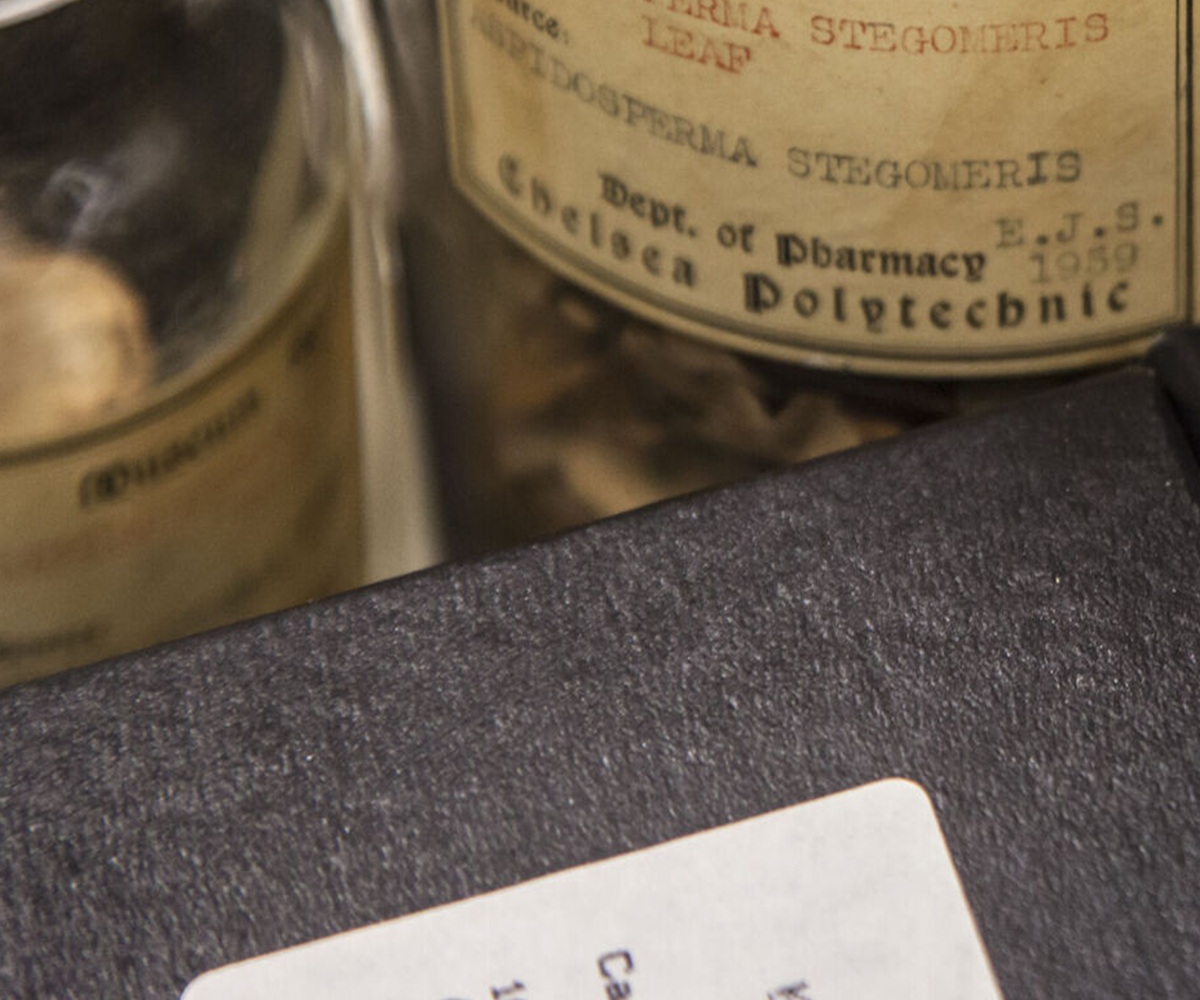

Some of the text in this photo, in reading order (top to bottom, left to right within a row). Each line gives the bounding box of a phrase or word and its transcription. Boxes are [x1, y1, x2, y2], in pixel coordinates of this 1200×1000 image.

[641, 13, 752, 75] LEAF
[810, 12, 1111, 56] STEGOMERIS
[786, 147, 1082, 191] STEGOMERIS
[498, 154, 1130, 335] Chelsea Polytechnic
[598, 170, 987, 283] Dept. of Pharmacy
